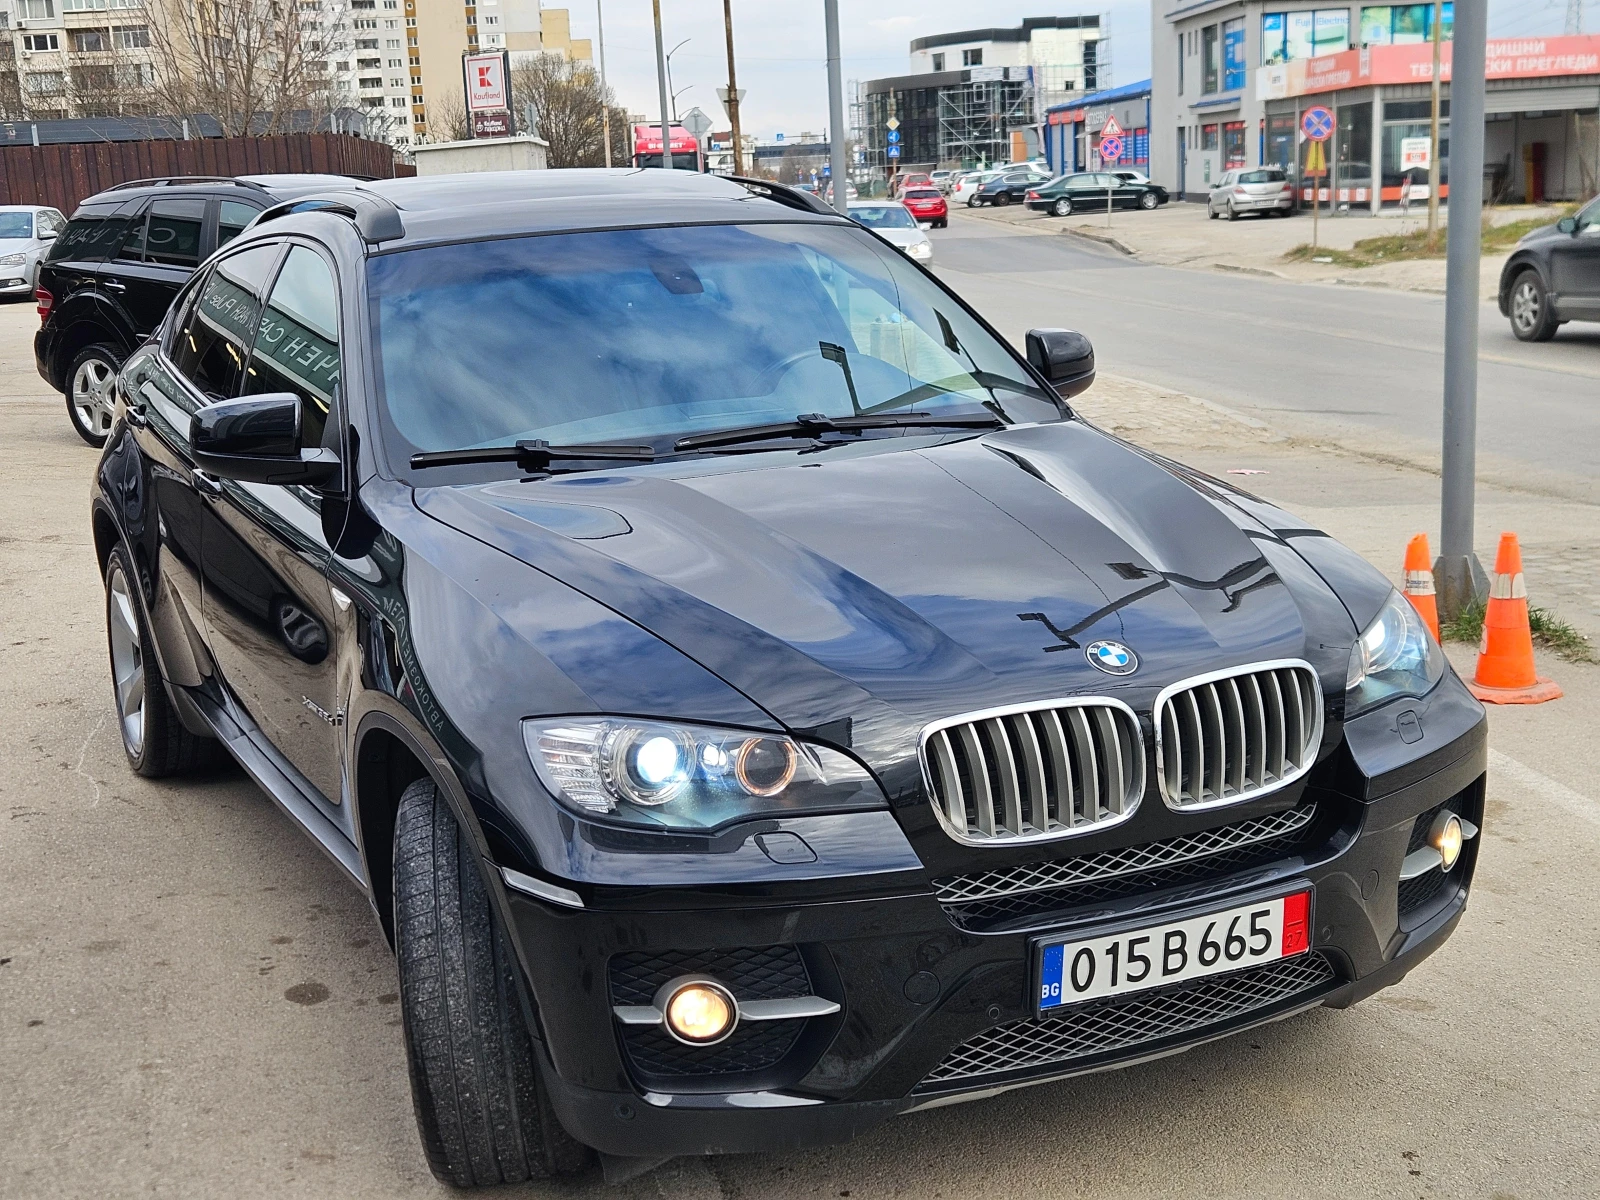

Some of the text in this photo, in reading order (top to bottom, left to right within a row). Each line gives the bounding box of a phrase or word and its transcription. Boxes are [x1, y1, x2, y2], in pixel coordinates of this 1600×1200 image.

[1295, 17, 1312, 27] Fuji
[1485, 40, 1546, 58] ДИШНИ
[1516, 53, 1598, 72] ПРЕГЛЕДИ
[473, 91, 501, 101] Kaufland
[1041, 983, 1060, 999] BG
